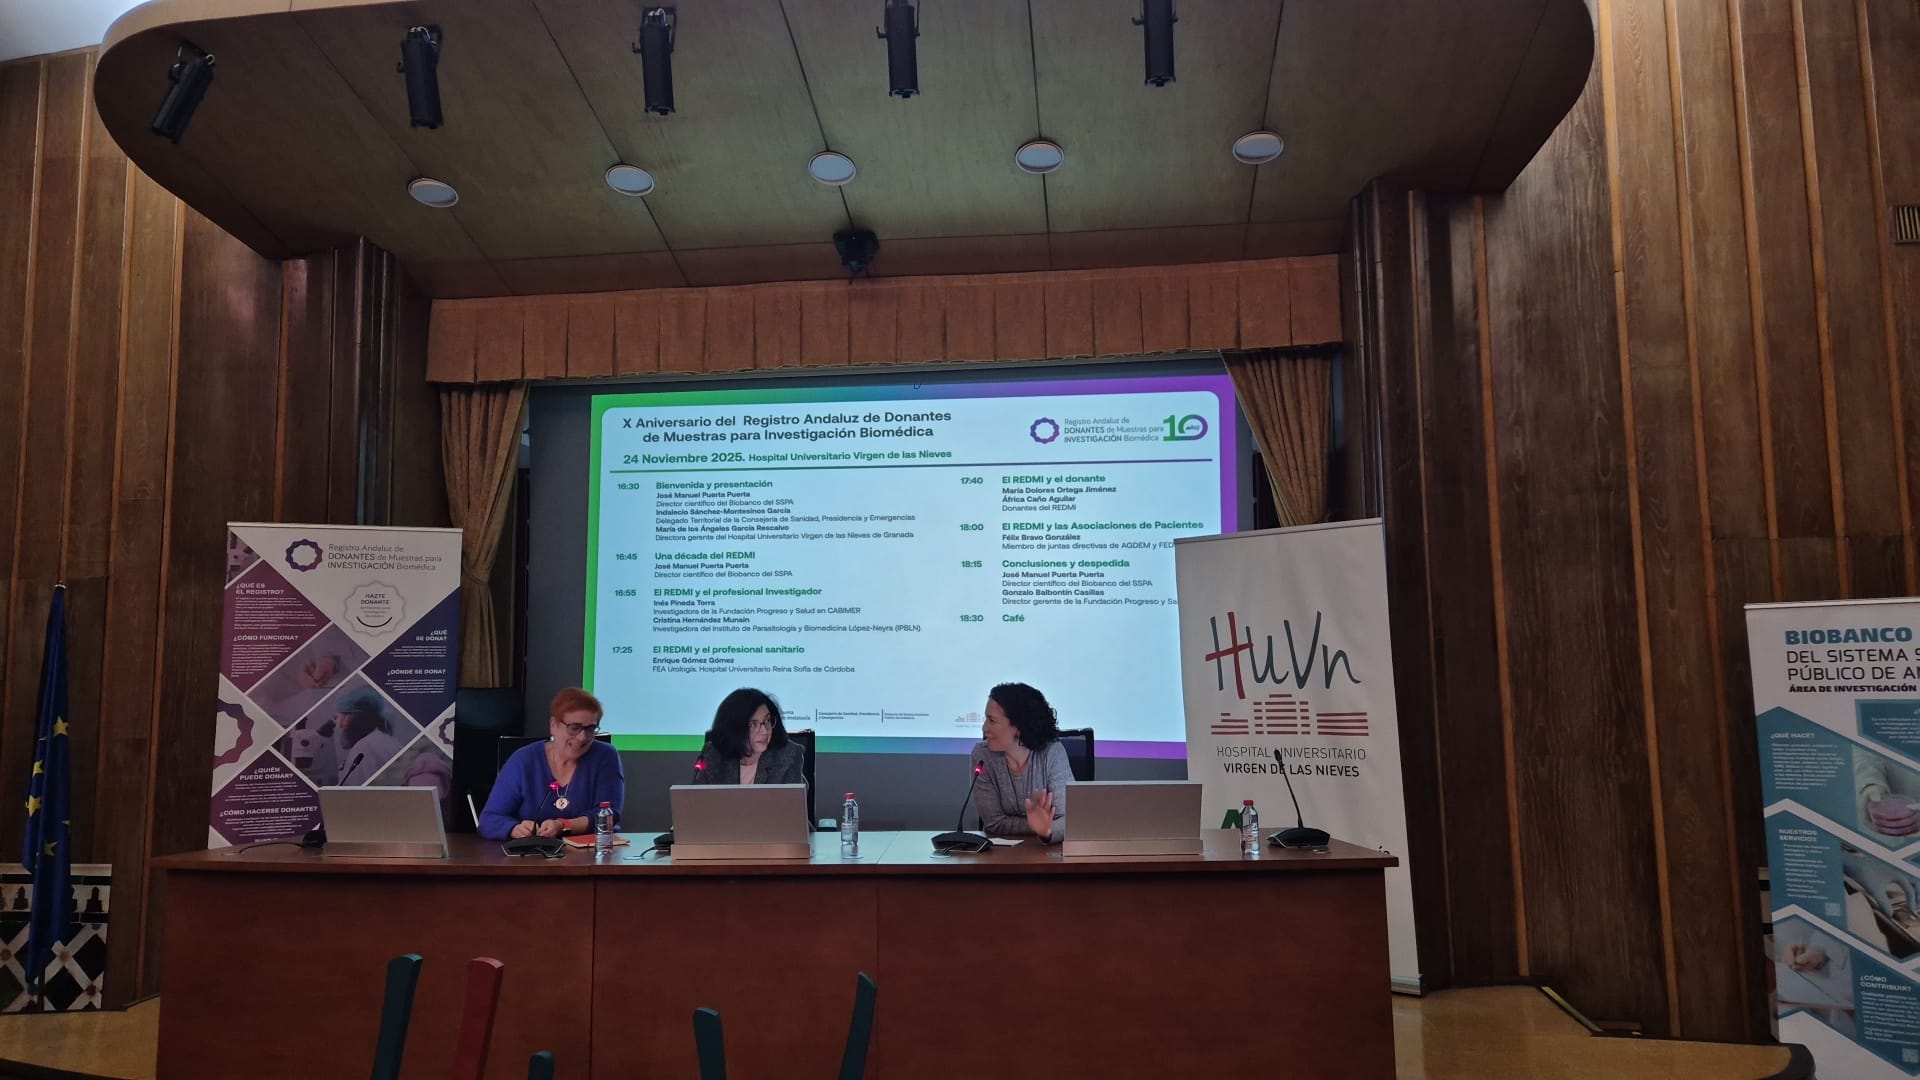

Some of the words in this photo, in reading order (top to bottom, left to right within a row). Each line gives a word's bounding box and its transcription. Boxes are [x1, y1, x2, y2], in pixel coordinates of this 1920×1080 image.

[623, 417, 632, 428] X
[635, 416, 711, 428] Aniversario
[714, 415, 736, 426] del
[742, 414, 800, 428] Registro
[803, 412, 859, 424] Andaluz
[862, 412, 880, 423] de
[883, 410, 952, 422] Donantes
[642, 432, 659, 442] de
[663, 430, 726, 442] Muestras
[729, 431, 760, 443] para
[764, 427, 856, 441] Investigación
[859, 425, 934, 438] Biomédica
[623, 454, 638, 464] 24
[641, 452, 708, 463] Noviembre
[710, 451, 746, 462] 2025.
[748, 452, 788, 462] Hospital
[789, 451, 851, 461] Universitario
[852, 451, 885, 462] Virgen
[886, 450, 900, 459] de
[901, 450, 916, 458] las
[918, 450, 952, 458] Nieves
[655, 481, 704, 489] Bienvenida
[705, 482, 712, 490] y
[713, 480, 773, 489] presentación
[1002, 475, 1010, 483] El
[1012, 475, 1044, 483] REDMI
[1045, 476, 1052, 485] y
[1053, 474, 1063, 482] el
[1064, 474, 1106, 482] donante
[1002, 522, 1011, 530] El
[1012, 522, 1044, 530] REDMI
[1046, 523, 1052, 532] y
[1053, 522, 1068, 530] las
[1070, 521, 1137, 530] Asociaciones
[1138, 520, 1152, 529] de
[1154, 520, 1204, 528] Pacientes
[329, 544, 360, 552] Registro
[328, 552, 376, 560] DONANTES
[654, 552, 672, 560] Una
[674, 551, 708, 559] década
[709, 551, 724, 559] del
[725, 551, 756, 559] REDMI
[328, 561, 395, 570] INVESTIGACIÓN
[1002, 559, 1067, 567] Conclusiones
[1069, 560, 1076, 570] y
[1077, 559, 1130, 568] despedida
[654, 588, 662, 596] El
[663, 588, 693, 596] REDMI
[694, 589, 700, 598] y
[702, 587, 711, 596] el
[712, 587, 764, 596] profesional
[764, 587, 822, 597] Investigador
[1002, 614, 1024, 622] Café
[1785, 626, 1912, 644] BIOBANCO
[653, 645, 661, 653] El
[662, 645, 693, 653] REDMI
[693, 647, 700, 656] y
[701, 645, 710, 653] el
[711, 645, 763, 654] profesional
[1786, 650, 1821, 663] DEL
[1826, 648, 1908, 662] SISTEMA
[1788, 665, 1865, 680] PÚBLICO
[1871, 666, 1895, 679] DE
[1217, 746, 1271, 758] HOSPITAL
[1274, 746, 1366, 760] NIVERSITARIO
[1223, 762, 1266, 774] VIRGEN
[1289, 764, 1312, 775] LAS
[1315, 764, 1359, 777] NIEVES
[1860, 981, 1911, 991] CONTRIBUIR?
